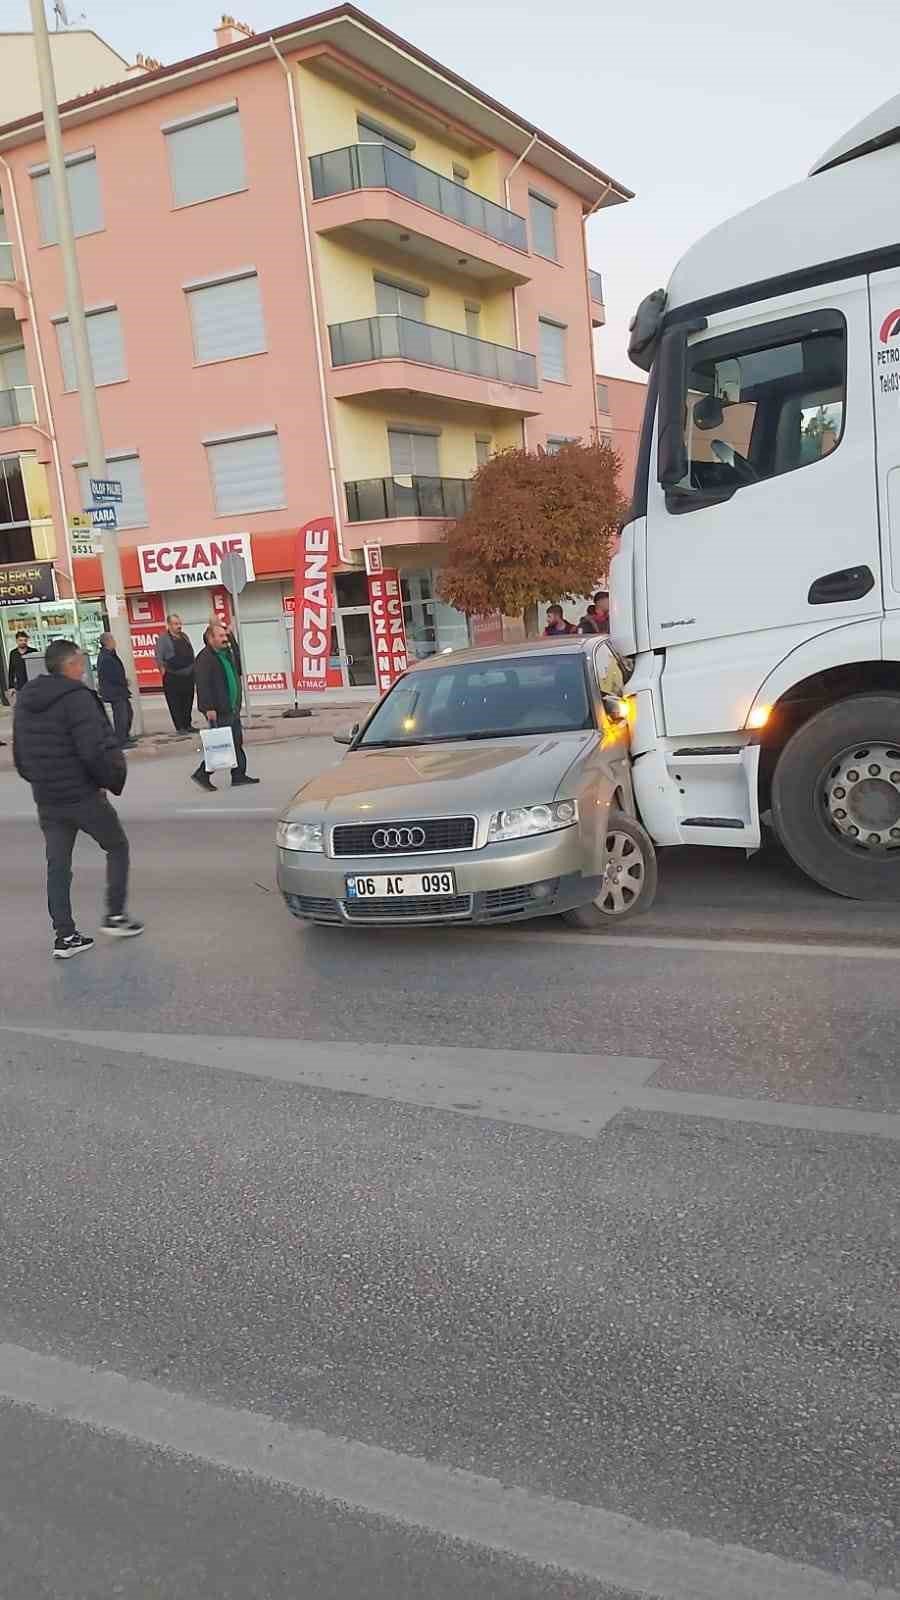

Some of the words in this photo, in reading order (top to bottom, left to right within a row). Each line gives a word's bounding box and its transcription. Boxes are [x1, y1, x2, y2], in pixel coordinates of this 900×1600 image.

[174, 571, 217, 585] ATMACA
[302, 529, 329, 679] ECZANE
[385, 580, 408, 678] ECZAN
[247, 673, 283, 683] ATMACA
[356, 878, 376, 896] 06
[386, 877, 404, 894] AC
[421, 874, 450, 893] 099
